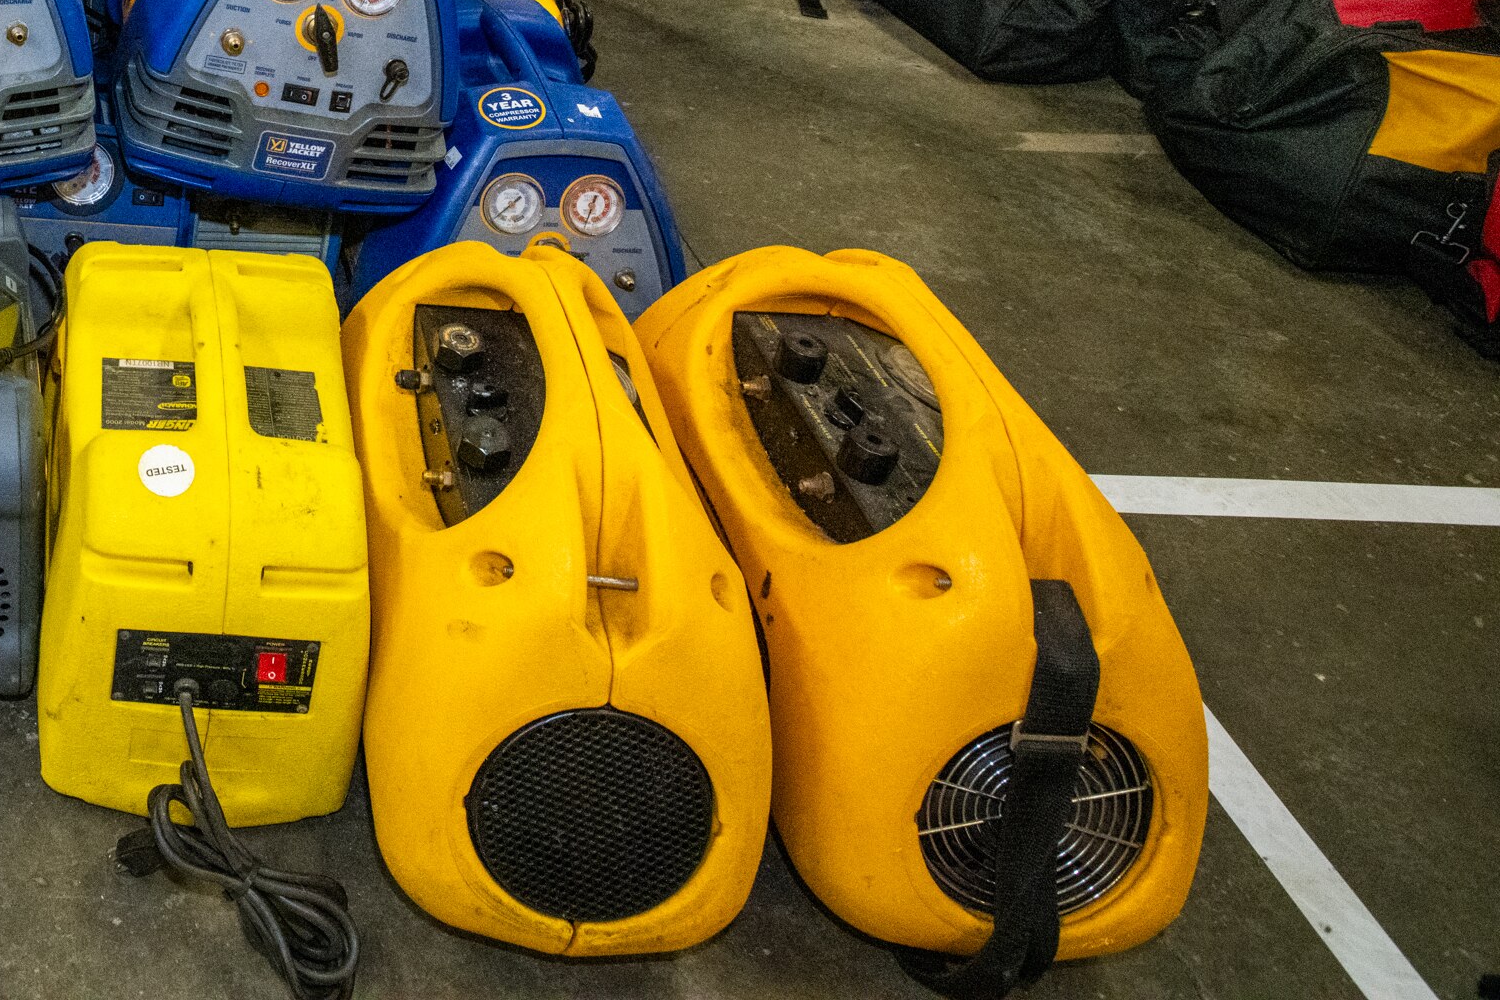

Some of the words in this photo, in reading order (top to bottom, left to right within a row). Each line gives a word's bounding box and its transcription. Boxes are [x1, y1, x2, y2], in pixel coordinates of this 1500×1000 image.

[226, 3, 250, 13] SUCTION
[386, 32, 417, 43] DISCHARGE
[501, 93, 512, 101] 3
[487, 99, 534, 112] YEAR
[489, 107, 540, 119] COMPRESSOR
[496, 114, 537, 124] WARRANTY
[269, 138, 286, 152] YJ
[289, 141, 326, 153] YELLOW
[286, 147, 321, 158] JACKET
[265, 156, 317, 171] RecoverXLT
[146, 463, 187, 477] TESTED
